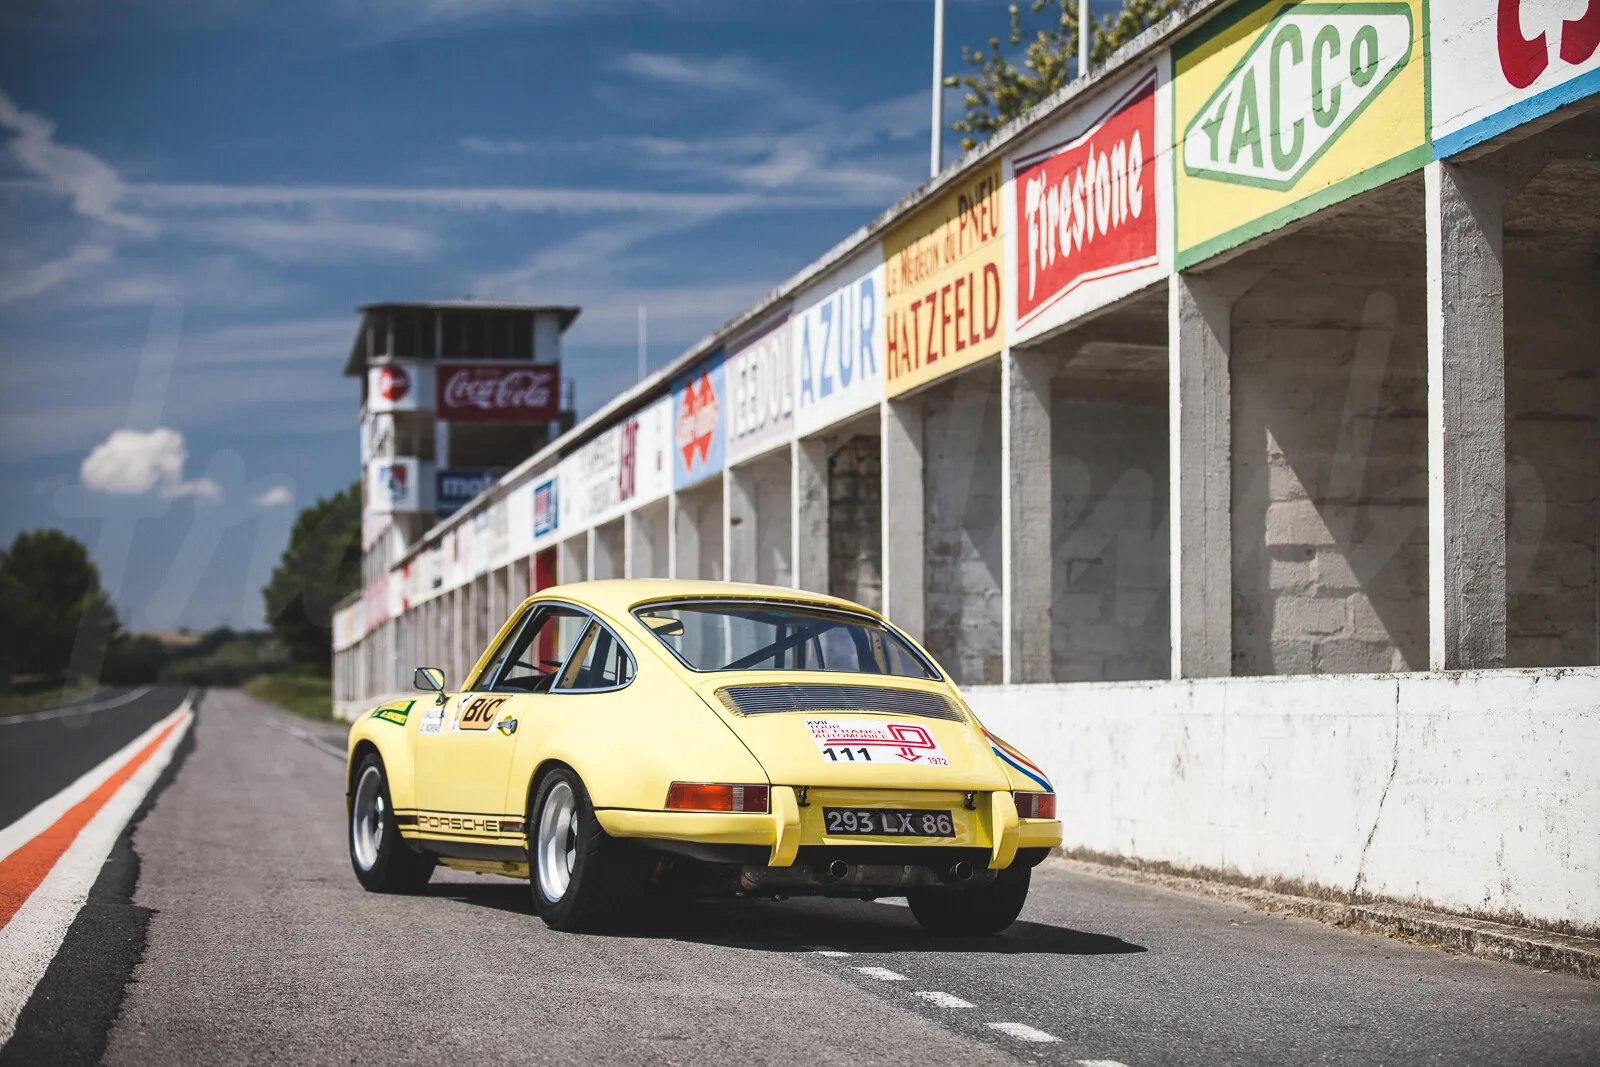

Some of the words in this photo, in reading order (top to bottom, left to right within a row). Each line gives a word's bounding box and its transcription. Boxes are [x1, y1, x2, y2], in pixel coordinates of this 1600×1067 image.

[1025, 129, 1143, 301] Firestone
[887, 262, 1000, 380] HATZFELD
[801, 277, 876, 407] AZUR
[823, 747, 872, 761] 111
[927, 757, 949, 765] 1972
[418, 815, 498, 832] PORSCHE
[827, 811, 874, 832] 293
[880, 812, 917, 833] LX
[922, 813, 951, 834] 86
